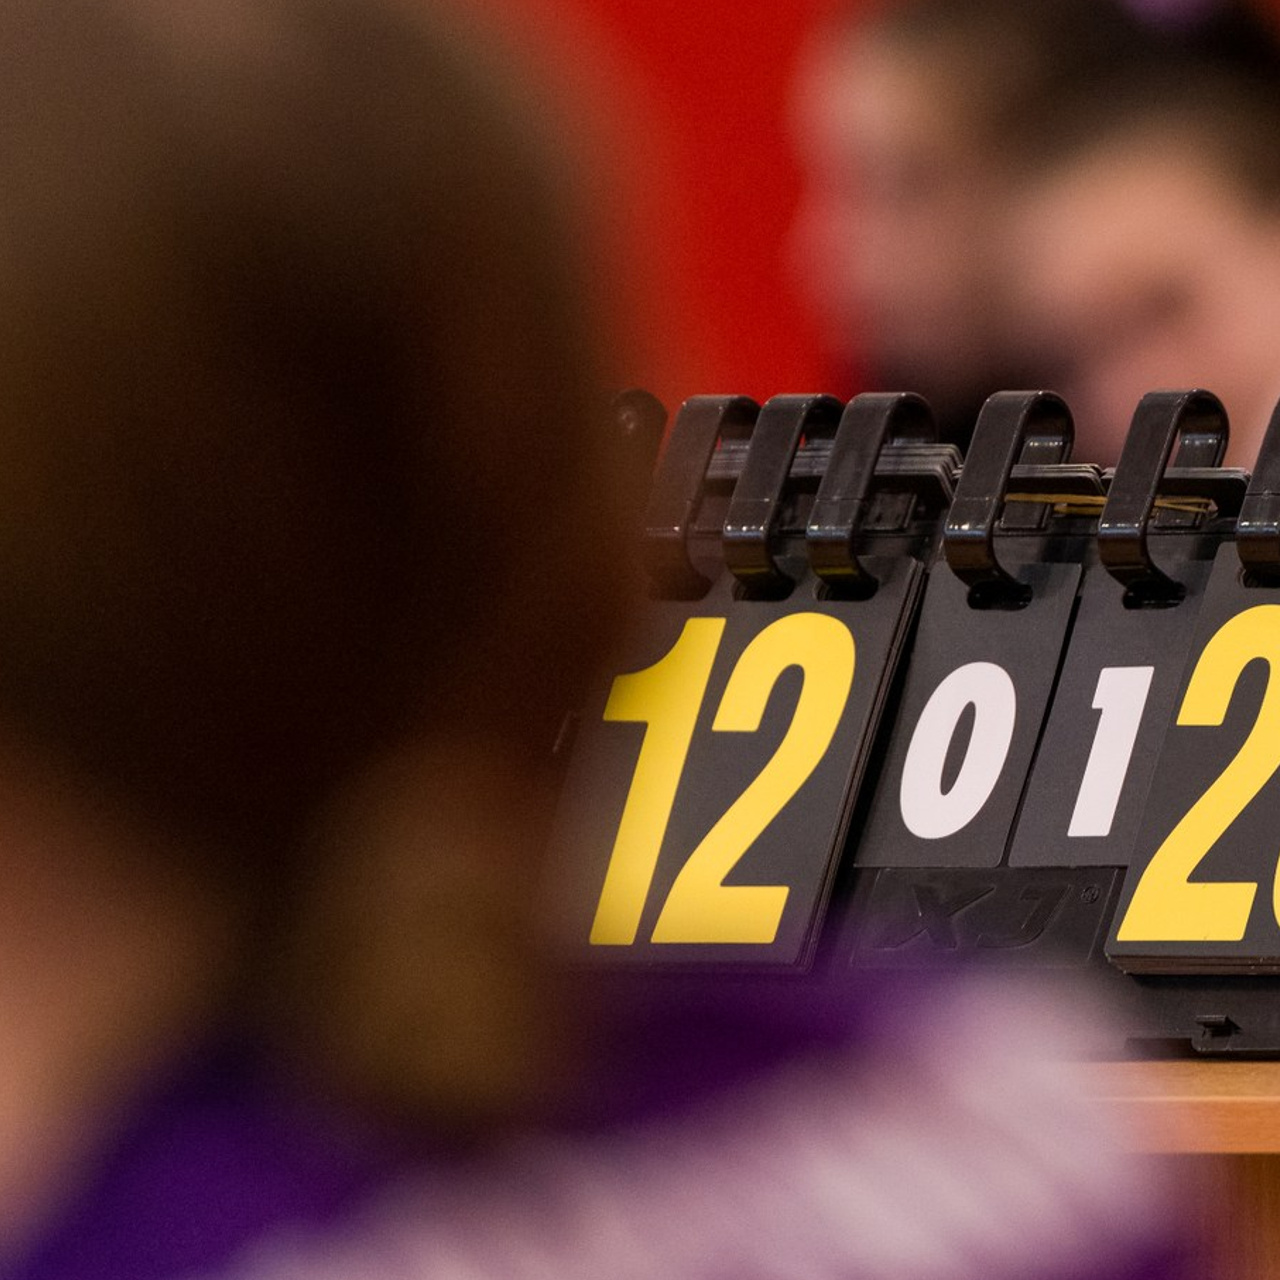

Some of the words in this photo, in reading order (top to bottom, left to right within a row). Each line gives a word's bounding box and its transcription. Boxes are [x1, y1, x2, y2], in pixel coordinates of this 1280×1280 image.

[589, 611, 856, 945] 12
[900, 662, 1017, 839] 0
[1067, 666, 1155, 837] 1
